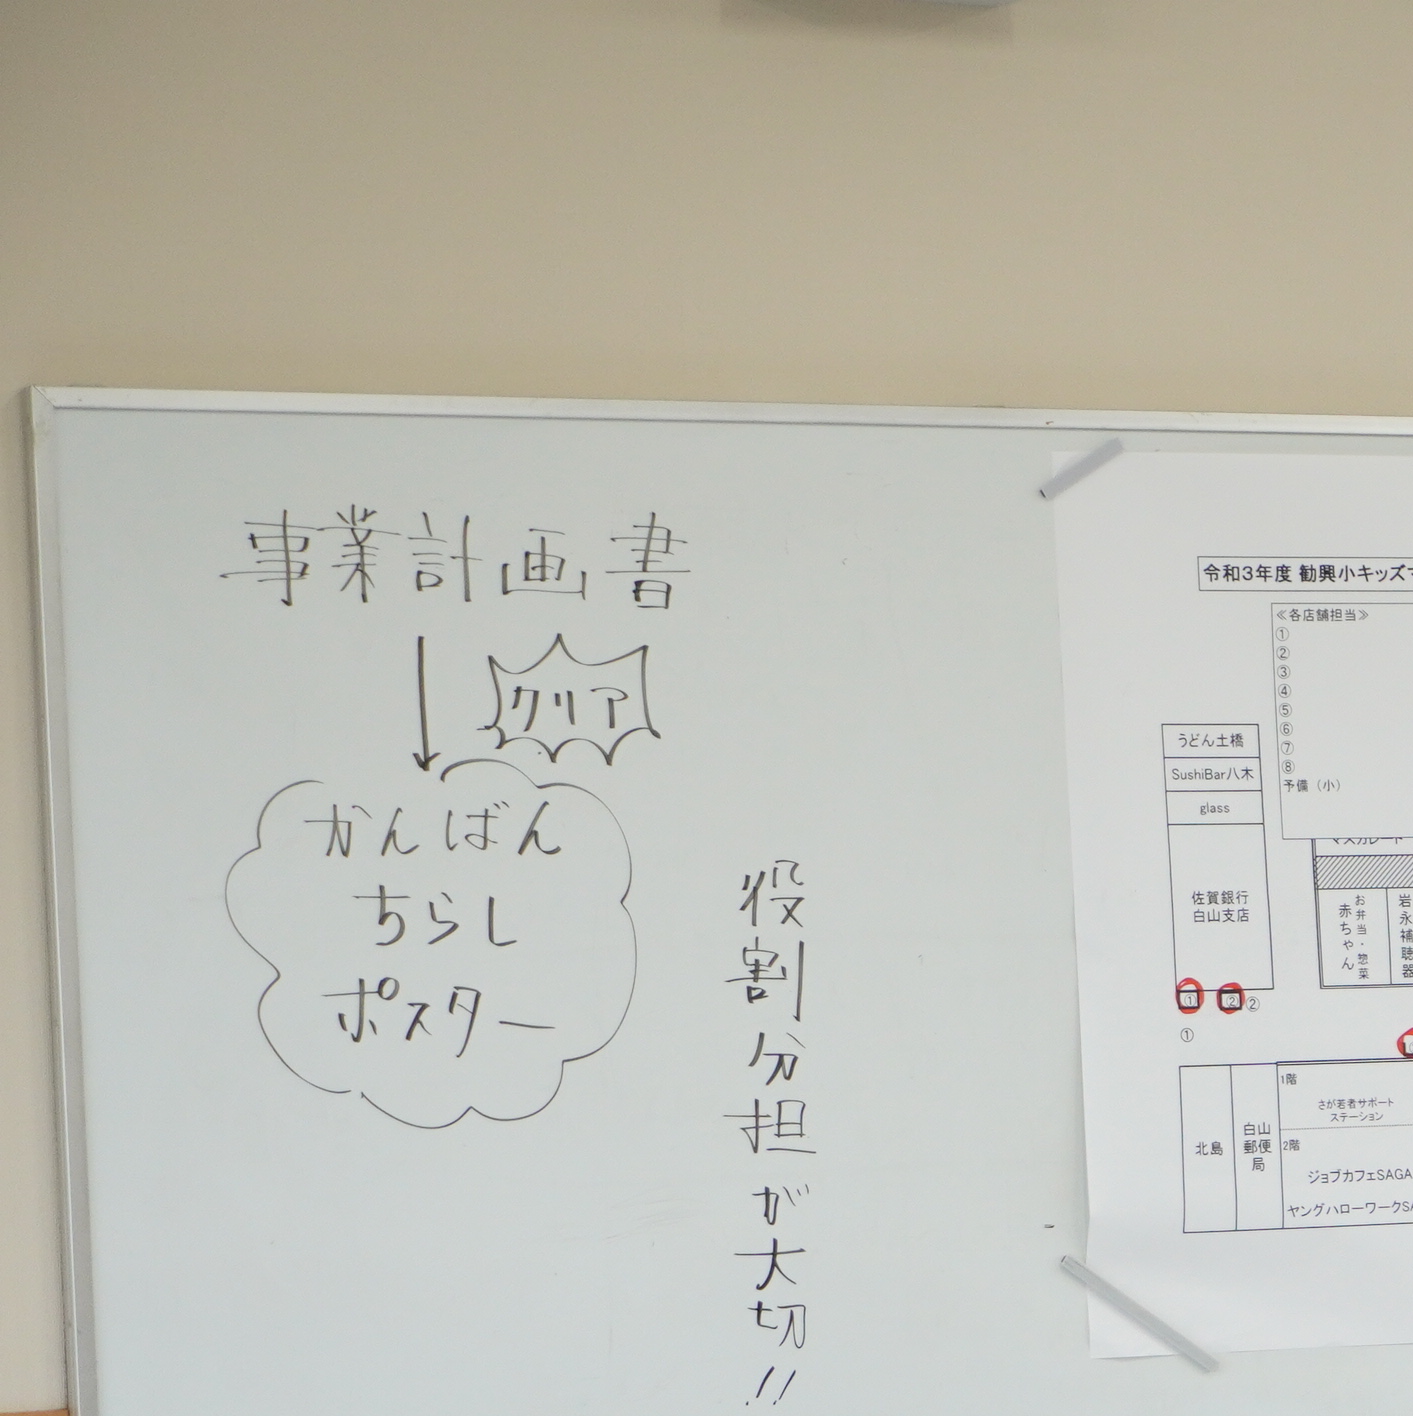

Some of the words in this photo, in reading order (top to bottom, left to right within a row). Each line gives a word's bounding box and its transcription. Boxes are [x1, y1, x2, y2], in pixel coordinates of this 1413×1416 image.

[219, 504, 690, 609] 事業計画書
[511, 686, 630, 732] クリア
[1178, 733, 1244, 748] うどん土橋
[1172, 766, 1254, 781] SushiBar八木
[1200, 800, 1230, 816] glass
[304, 801, 562, 857] かんばん
[1191, 891, 1249, 906] 佐賀銀行
[353, 885, 517, 947] ちらし
[1193, 908, 1250, 923] 白山支店
[1338, 903, 1355, 971] 赤ちゃん
[1355, 894, 1370, 980] お弁当・惣菜
[321, 976, 556, 1058] ポスター
[1281, 1073, 1298, 1086] 1階
[1318, 1097, 1395, 1110] さが若者サポート
[1330, 1112, 1384, 1122] ステーション
[1243, 1122, 1271, 1136] 白山
[1195, 1141, 1224, 1156] 北島
[1243, 1138, 1272, 1154] 郵便
[1283, 1139, 1300, 1151] 2階
[1252, 1157, 1265, 1171] 局
[1308, 1168, 1413, 1184] ジョブカフェSAGA
